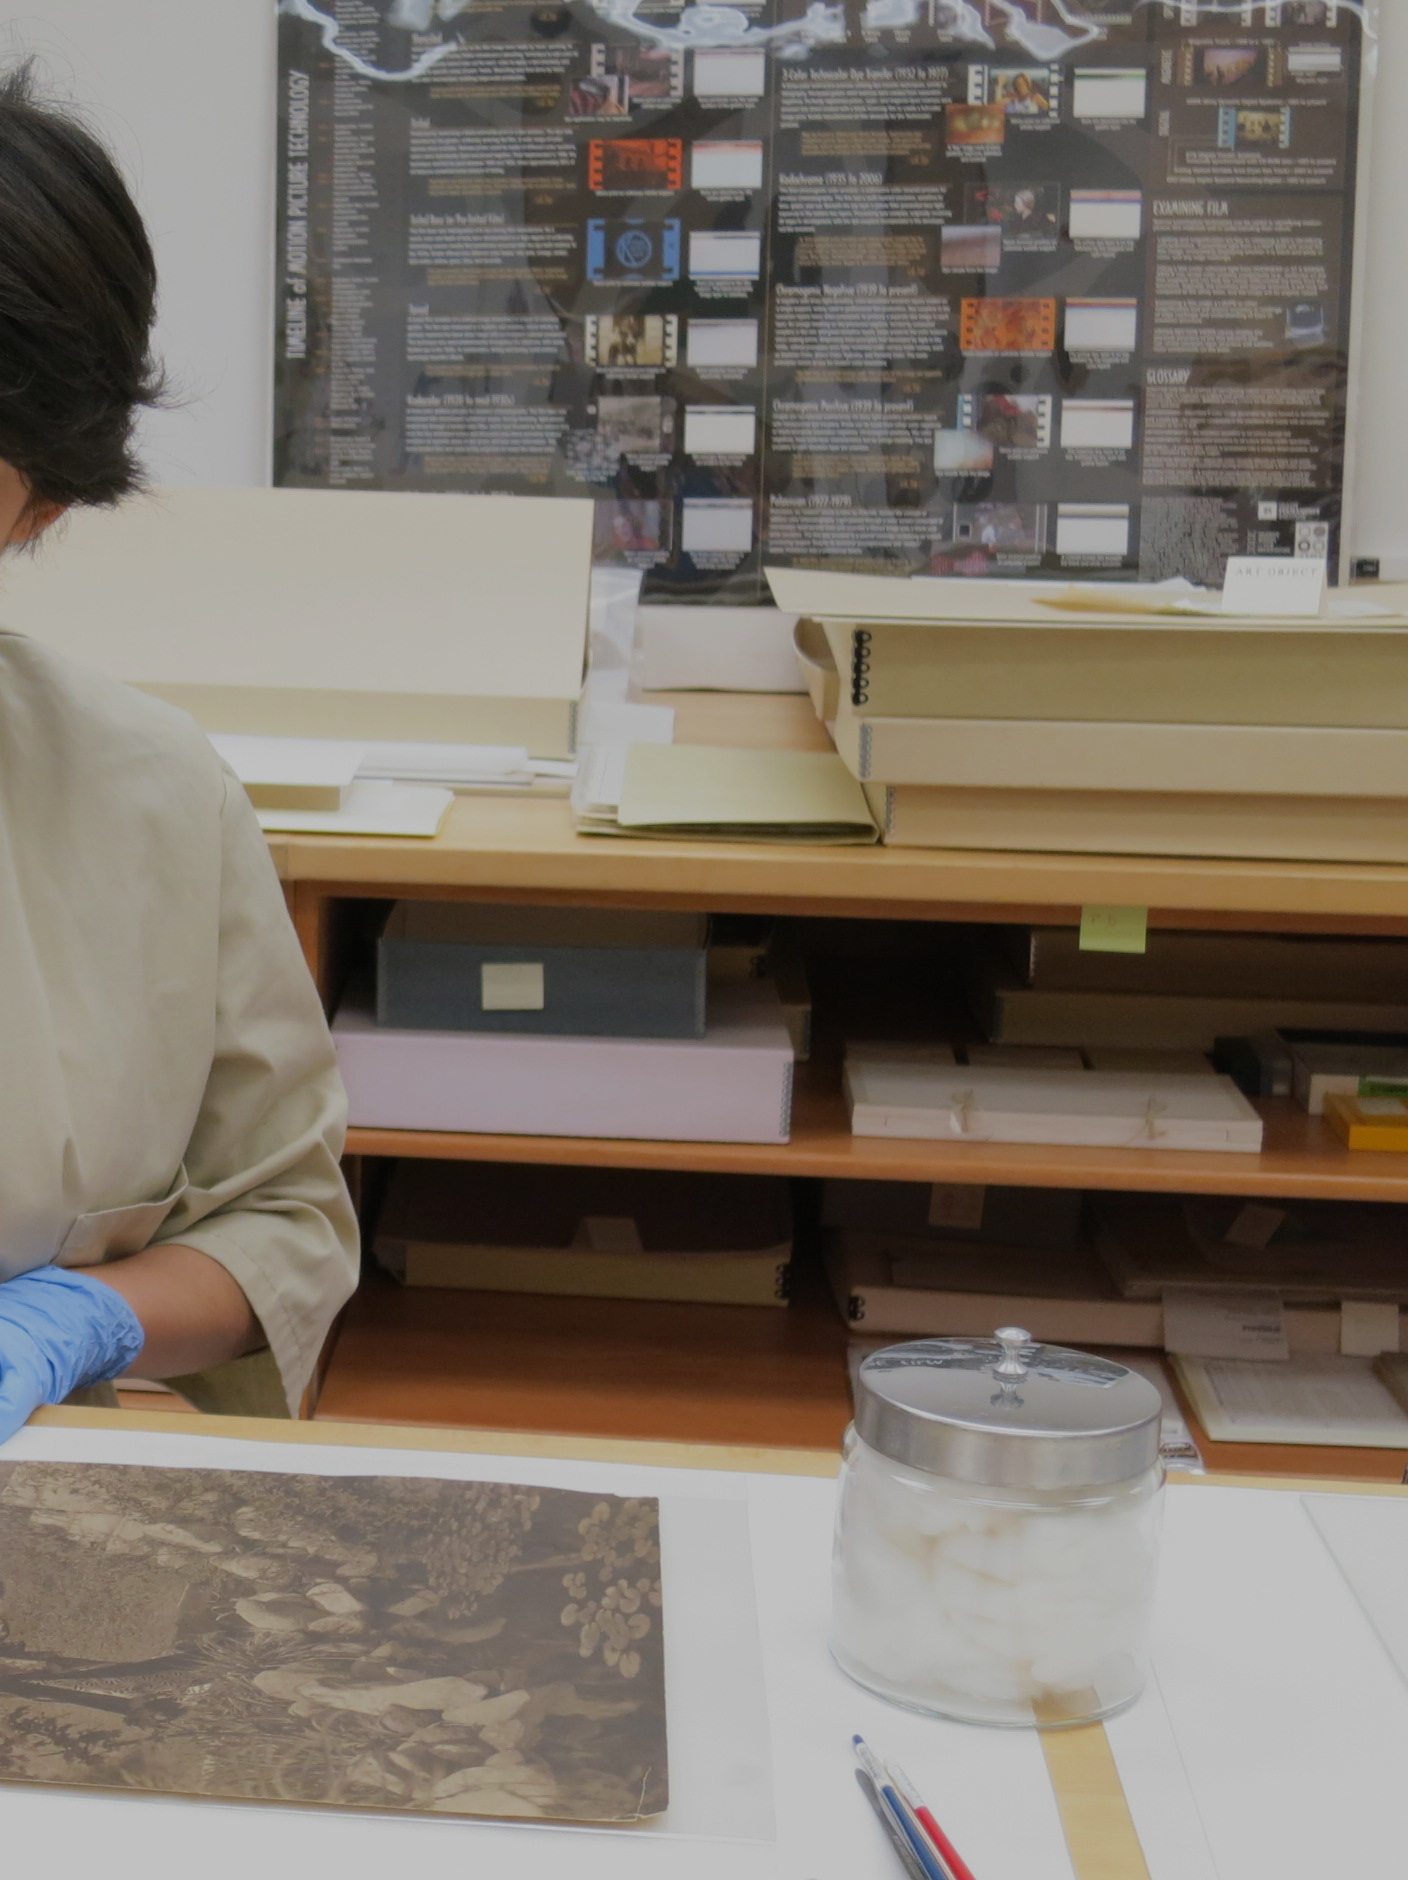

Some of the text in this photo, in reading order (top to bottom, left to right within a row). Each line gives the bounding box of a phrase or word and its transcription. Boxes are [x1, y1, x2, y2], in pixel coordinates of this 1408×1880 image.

[285, 69, 311, 360] TIMELINE of MOTION PICTURE TECHNOLOGY
[1152, 199, 1229, 216] EXAMINING FILM
[1146, 368, 1191, 386] GLOSSARY
[1236, 566, 1319, 577] ART OBJECT
